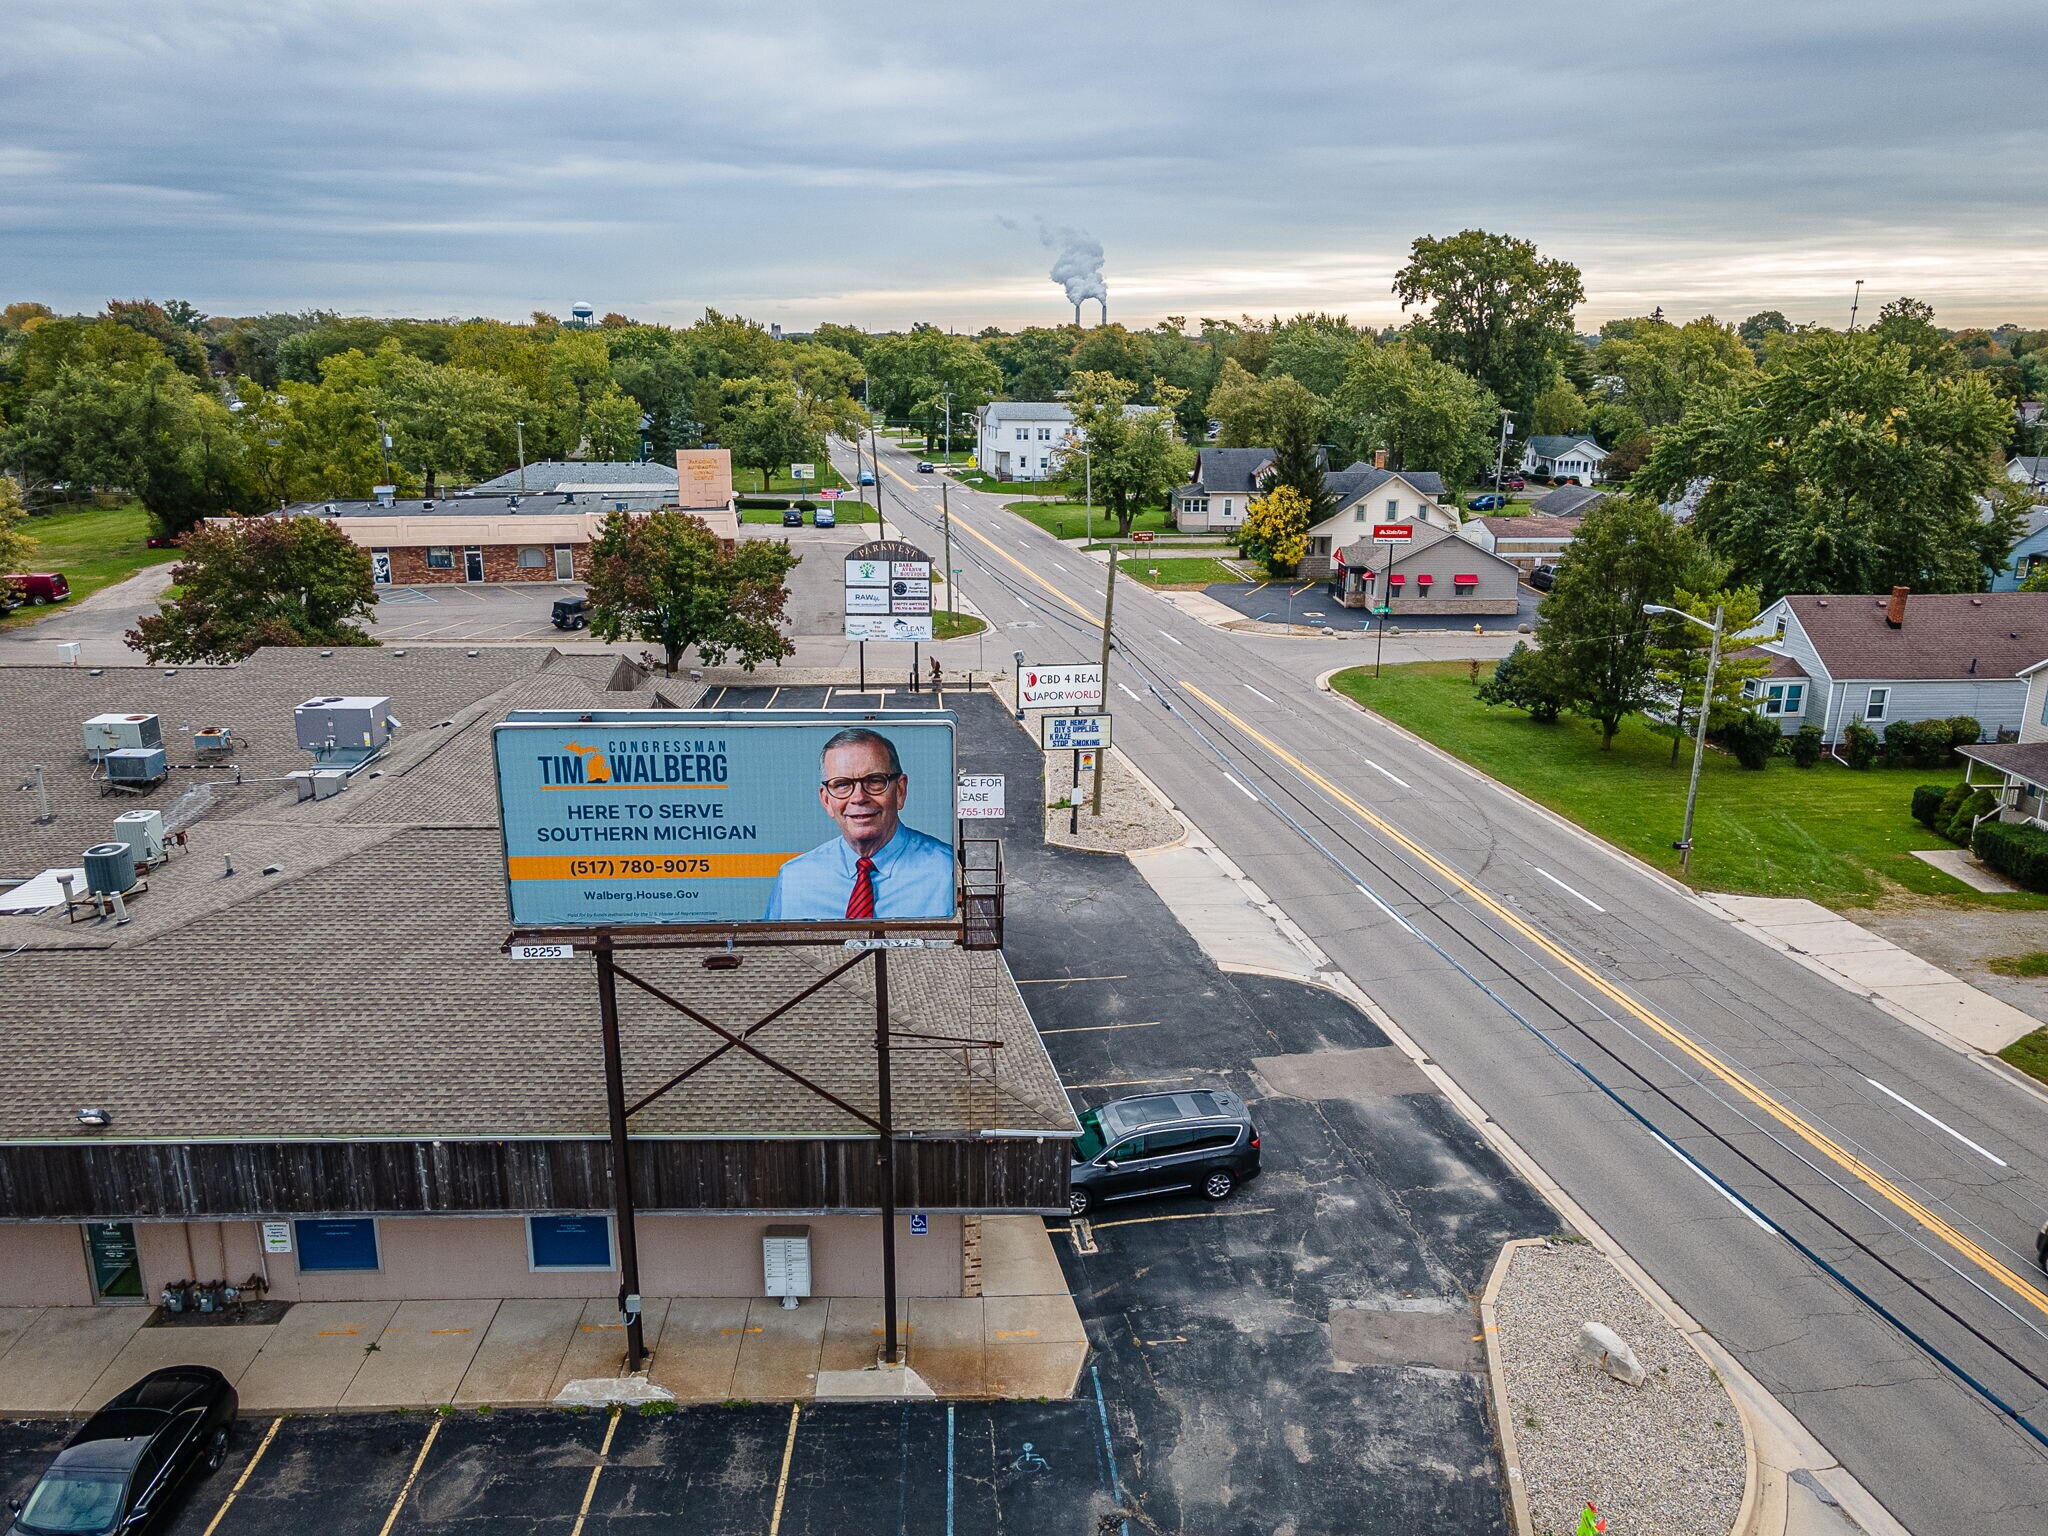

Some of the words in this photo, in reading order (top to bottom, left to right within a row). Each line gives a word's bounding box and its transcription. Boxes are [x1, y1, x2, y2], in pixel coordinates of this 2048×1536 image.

[858, 543, 918, 558] PARKWEST
[1040, 674, 1060, 684] CBD
[1064, 674, 1071, 683] 4
[1074, 673, 1101, 683] REAL
[608, 740, 727, 753] CONGRESSMAN
[537, 755, 584, 784] TIM
[609, 754, 728, 783] WALBERG
[980, 778, 1002, 787] FOR
[567, 805, 620, 819] HERE
[625, 804, 653, 819] TO
[659, 803, 724, 819] SERVE
[958, 807, 1004, 816] -755-1970
[537, 826, 649, 842] SOUTHERN
[654, 825, 757, 841] MICHIGAN
[570, 861, 614, 876] (517)
[619, 859, 710, 874] 780-9075
[583, 889, 699, 902] Walberg.House.Gov
[523, 946, 562, 958] 82255
